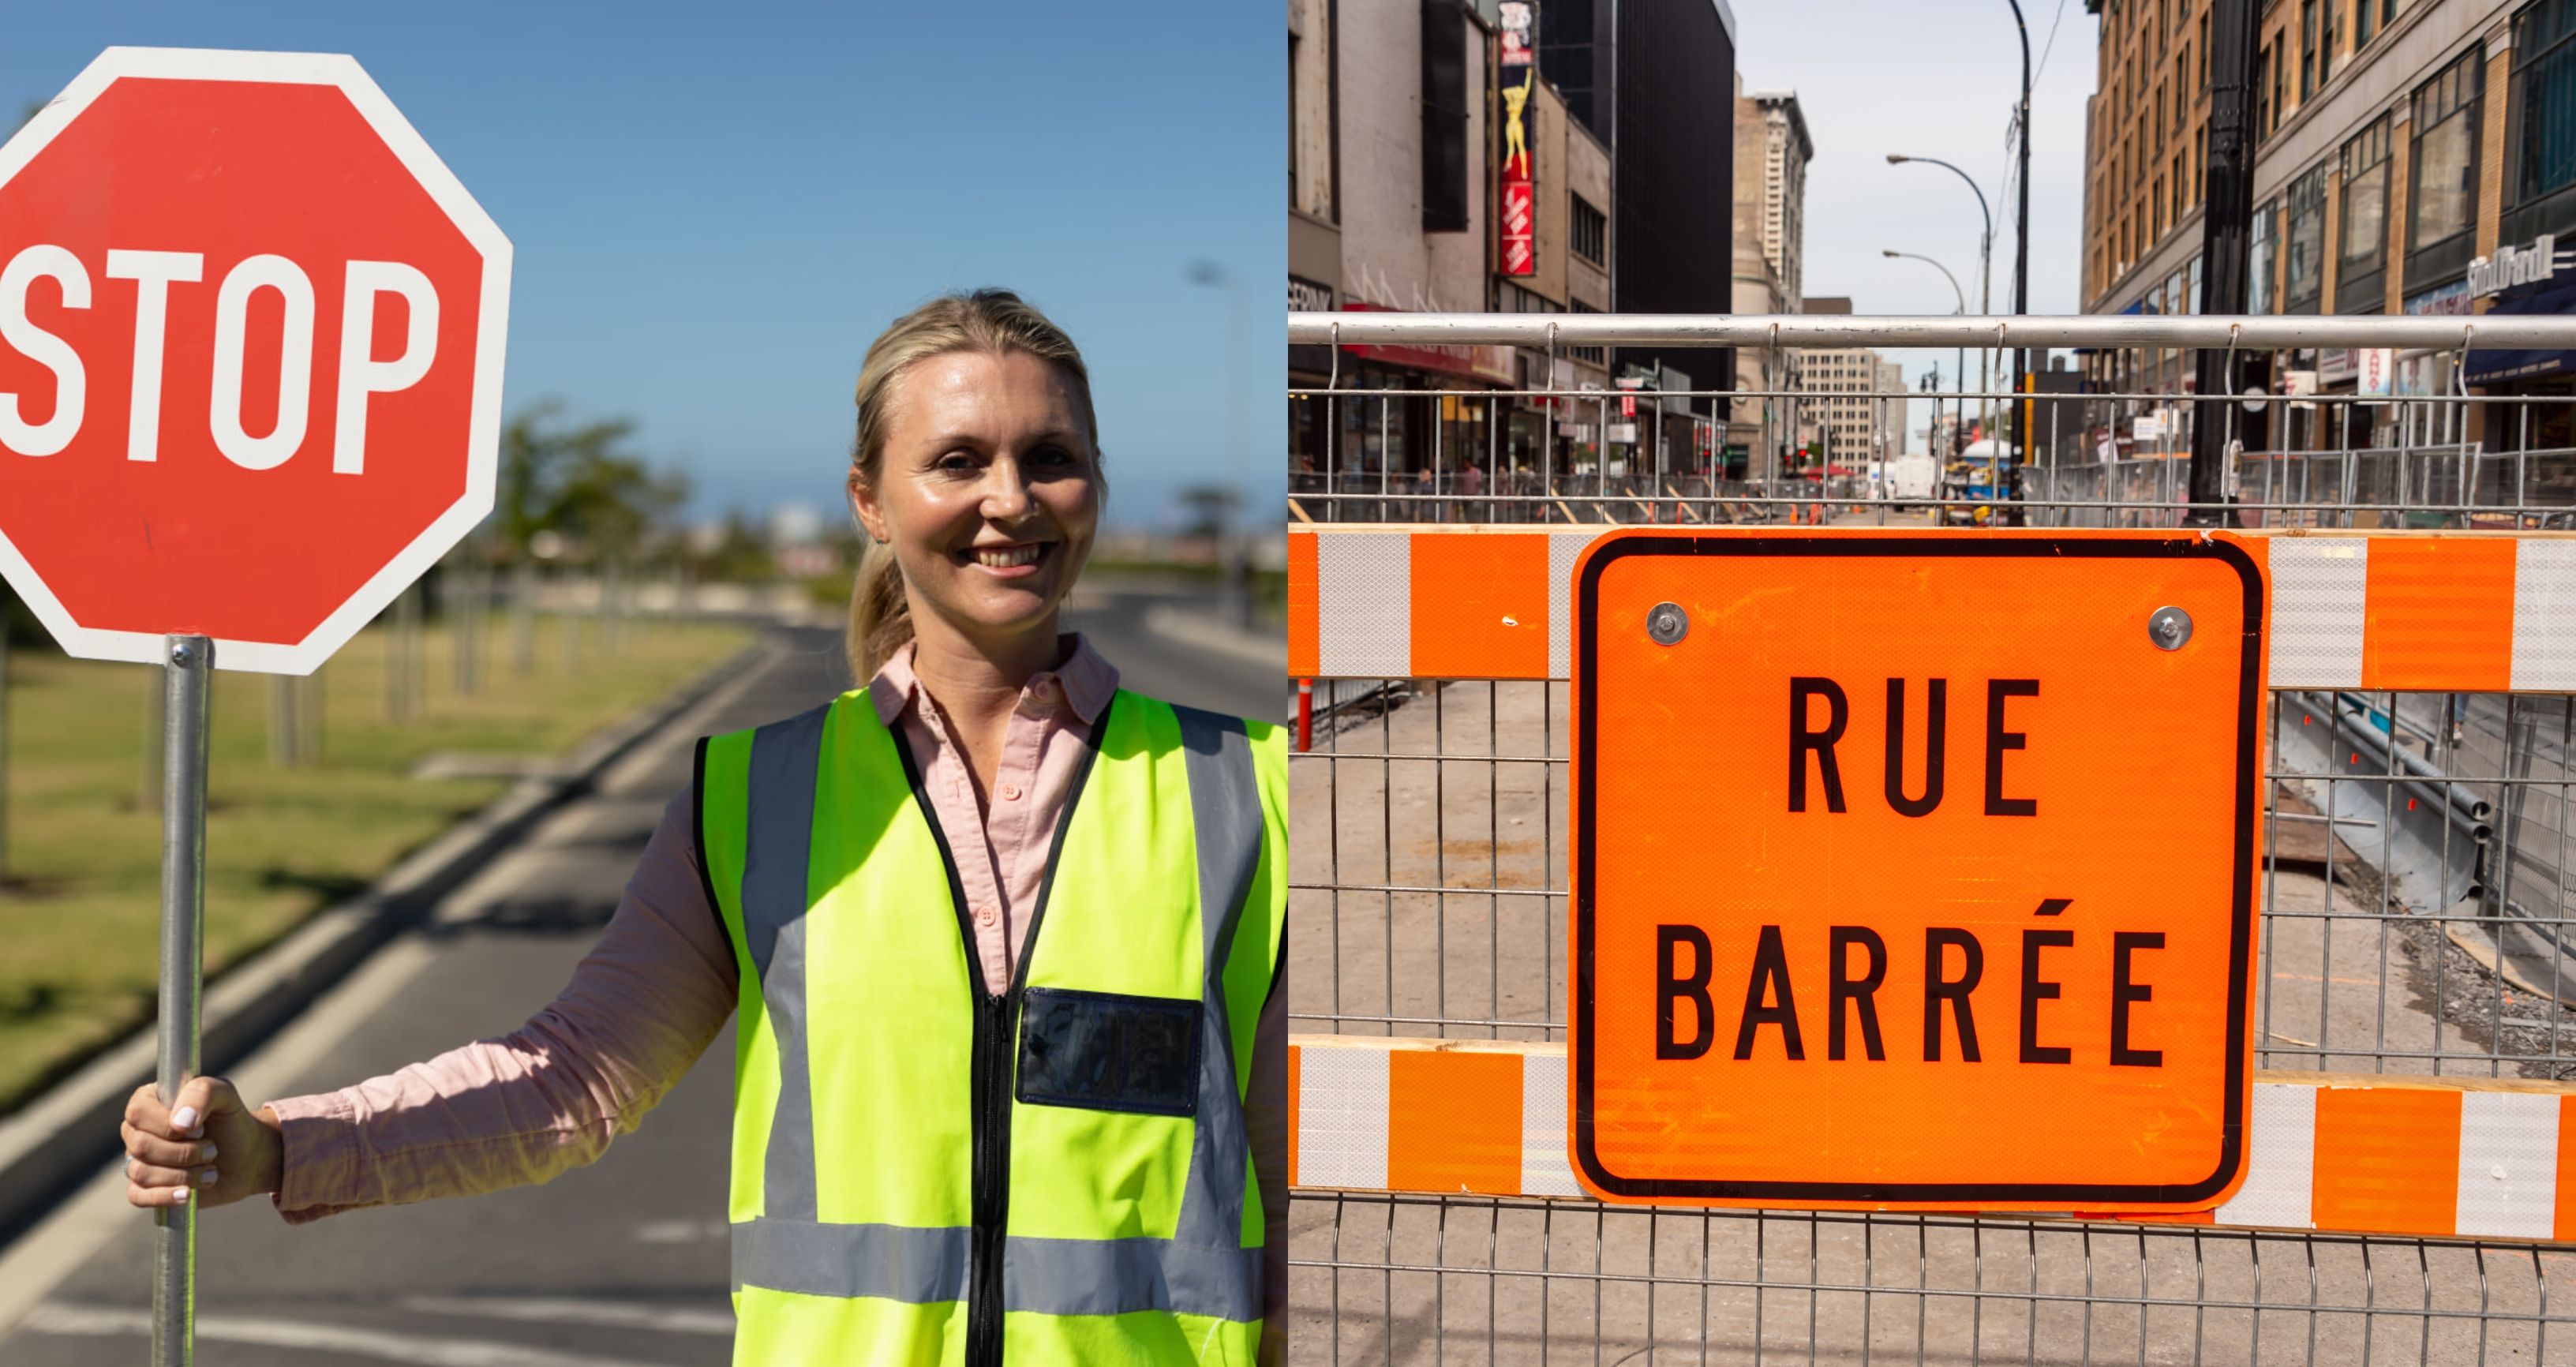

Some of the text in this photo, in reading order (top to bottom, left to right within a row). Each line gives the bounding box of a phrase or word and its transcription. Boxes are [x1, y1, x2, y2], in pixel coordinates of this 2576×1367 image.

[0, 244, 440, 475] STOP
[1788, 676, 2039, 818] RUE
[1656, 898, 2166, 1068] BARRÉE
